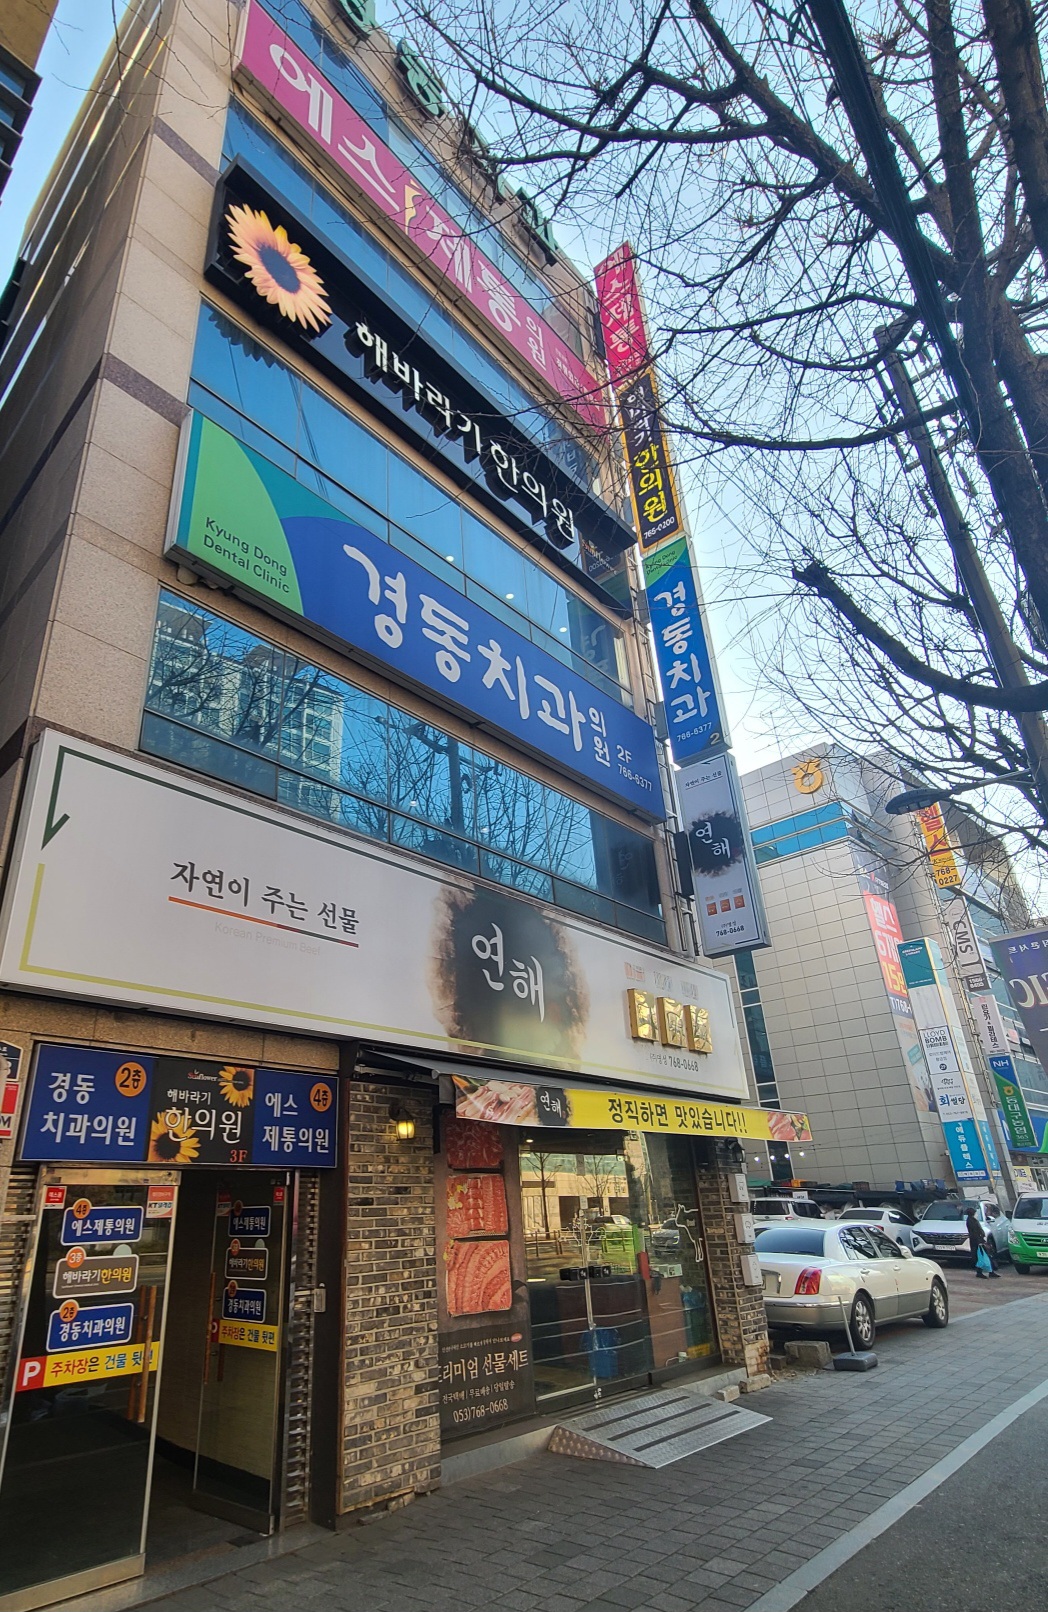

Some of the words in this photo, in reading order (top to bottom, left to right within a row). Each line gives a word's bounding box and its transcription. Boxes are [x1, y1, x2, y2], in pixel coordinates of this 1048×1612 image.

[355, 321, 481, 455] 해바라기
[490, 439, 574, 543] 한의원
[643, 516, 675, 540] 765-0200
[206, 517, 249, 554] Kyung
[254, 545, 287, 577] Dong
[203, 534, 249, 570] Dental
[253, 565, 290, 593] Clinic
[343, 544, 586, 751] 경동치과
[589, 707, 610, 767] 의원
[653, 580, 711, 724] 경동치과
[616, 744, 632, 763] 2F
[618, 763, 652, 791] 766-6377
[695, 821, 732, 859] 연해
[938, 874, 958, 886] 0227
[170, 861, 249, 907] 자연이
[261, 885, 309, 921] 주는
[317, 902, 360, 935] 선물
[214, 921, 252, 941] Korean
[256, 932, 298, 951] Premium
[953, 920, 974, 954] CMS
[471, 923, 545, 1023] 연해
[48, 1071, 96, 1105] 경동
[119, 1065, 142, 1090] 2층
[166, 1088, 212, 1106] 해바라기
[265, 1092, 299, 1117] 에스
[312, 1087, 330, 1108] 4층
[539, 1092, 562, 1119] 연해
[40, 1112, 137, 1146] 치과의원
[164, 1105, 243, 1144] 한의원
[606, 1097, 669, 1129] 정직하면
[675, 1104, 749, 1134] 맛있습니다!!
[262, 1124, 330, 1154] 제통의원
[229, 1150, 248, 1163] 3F
[71, 1217, 136, 1237] 에스제통의원
[59, 1316, 126, 1342] 경동치과의원
[22, 1360, 41, 1386] P
[50, 1356, 99, 1378] 주차장은
[104, 1353, 127, 1370] 건물
[482, 1350, 529, 1376] 선물세트
[452, 1398, 508, 1423] 053)768-0668
